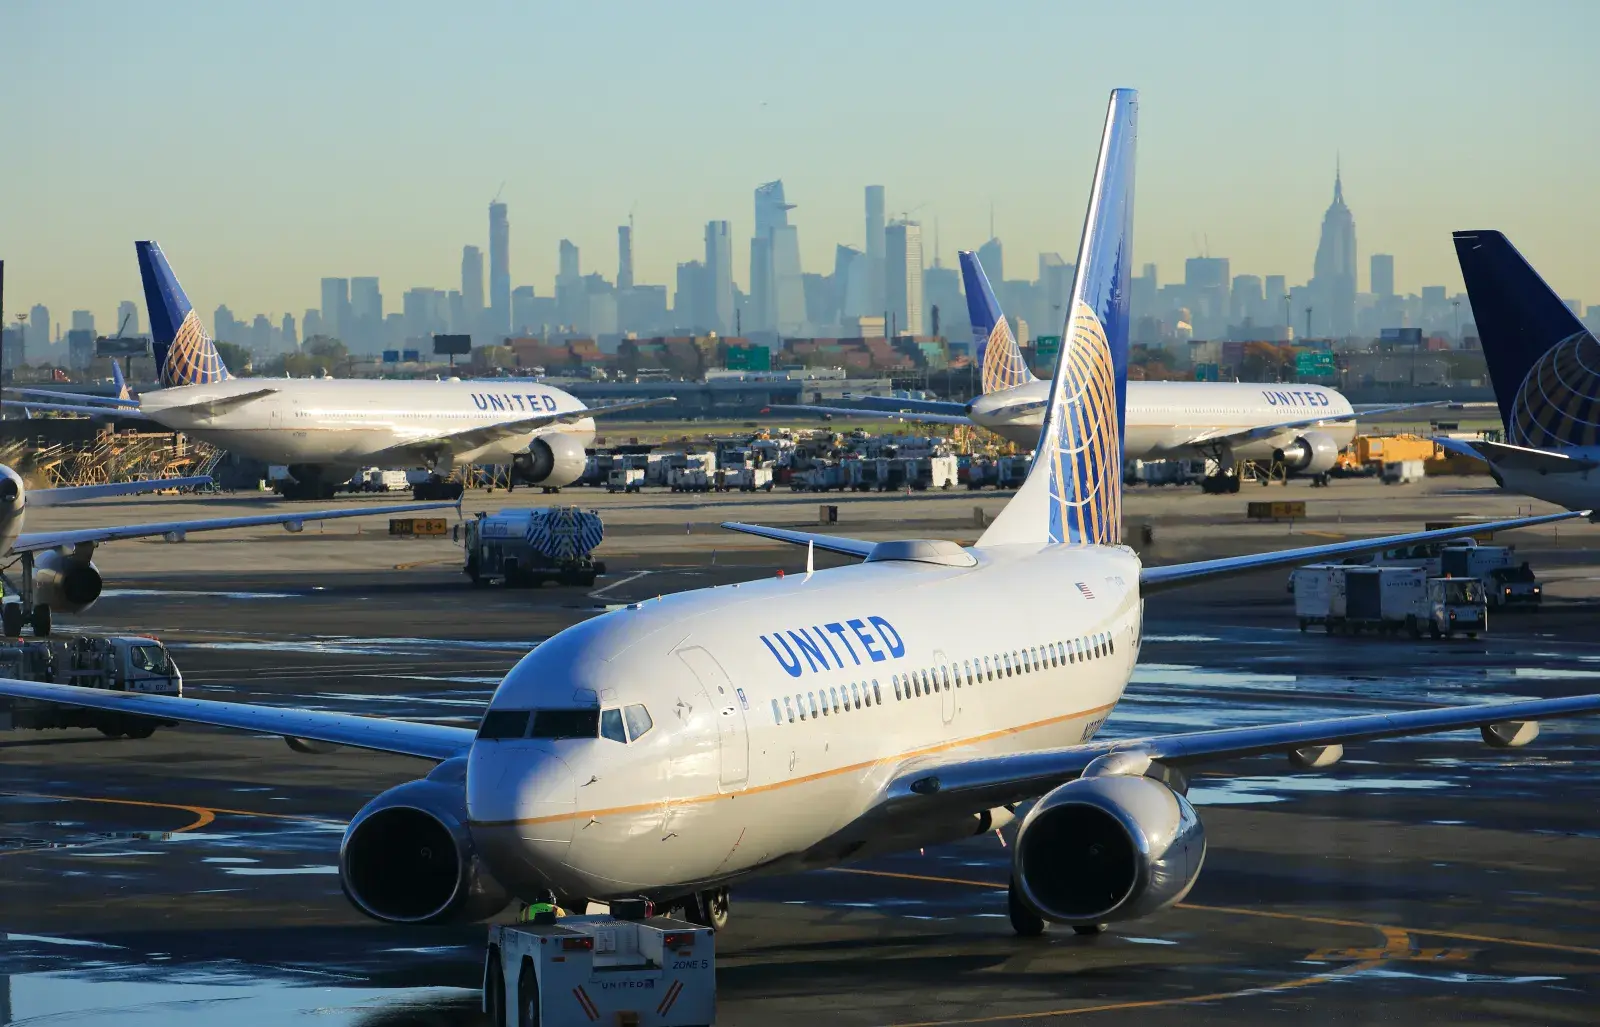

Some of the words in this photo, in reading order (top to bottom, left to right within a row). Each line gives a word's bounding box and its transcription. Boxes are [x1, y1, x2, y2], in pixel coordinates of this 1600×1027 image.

[470, 393, 557, 411] UNITED
[1261, 391, 1329, 406] UNITED
[759, 616, 905, 678] UNITED
[672, 961, 698, 970] ZONE
[700, 960, 708, 969] 5
[602, 981, 644, 989] UNITED
